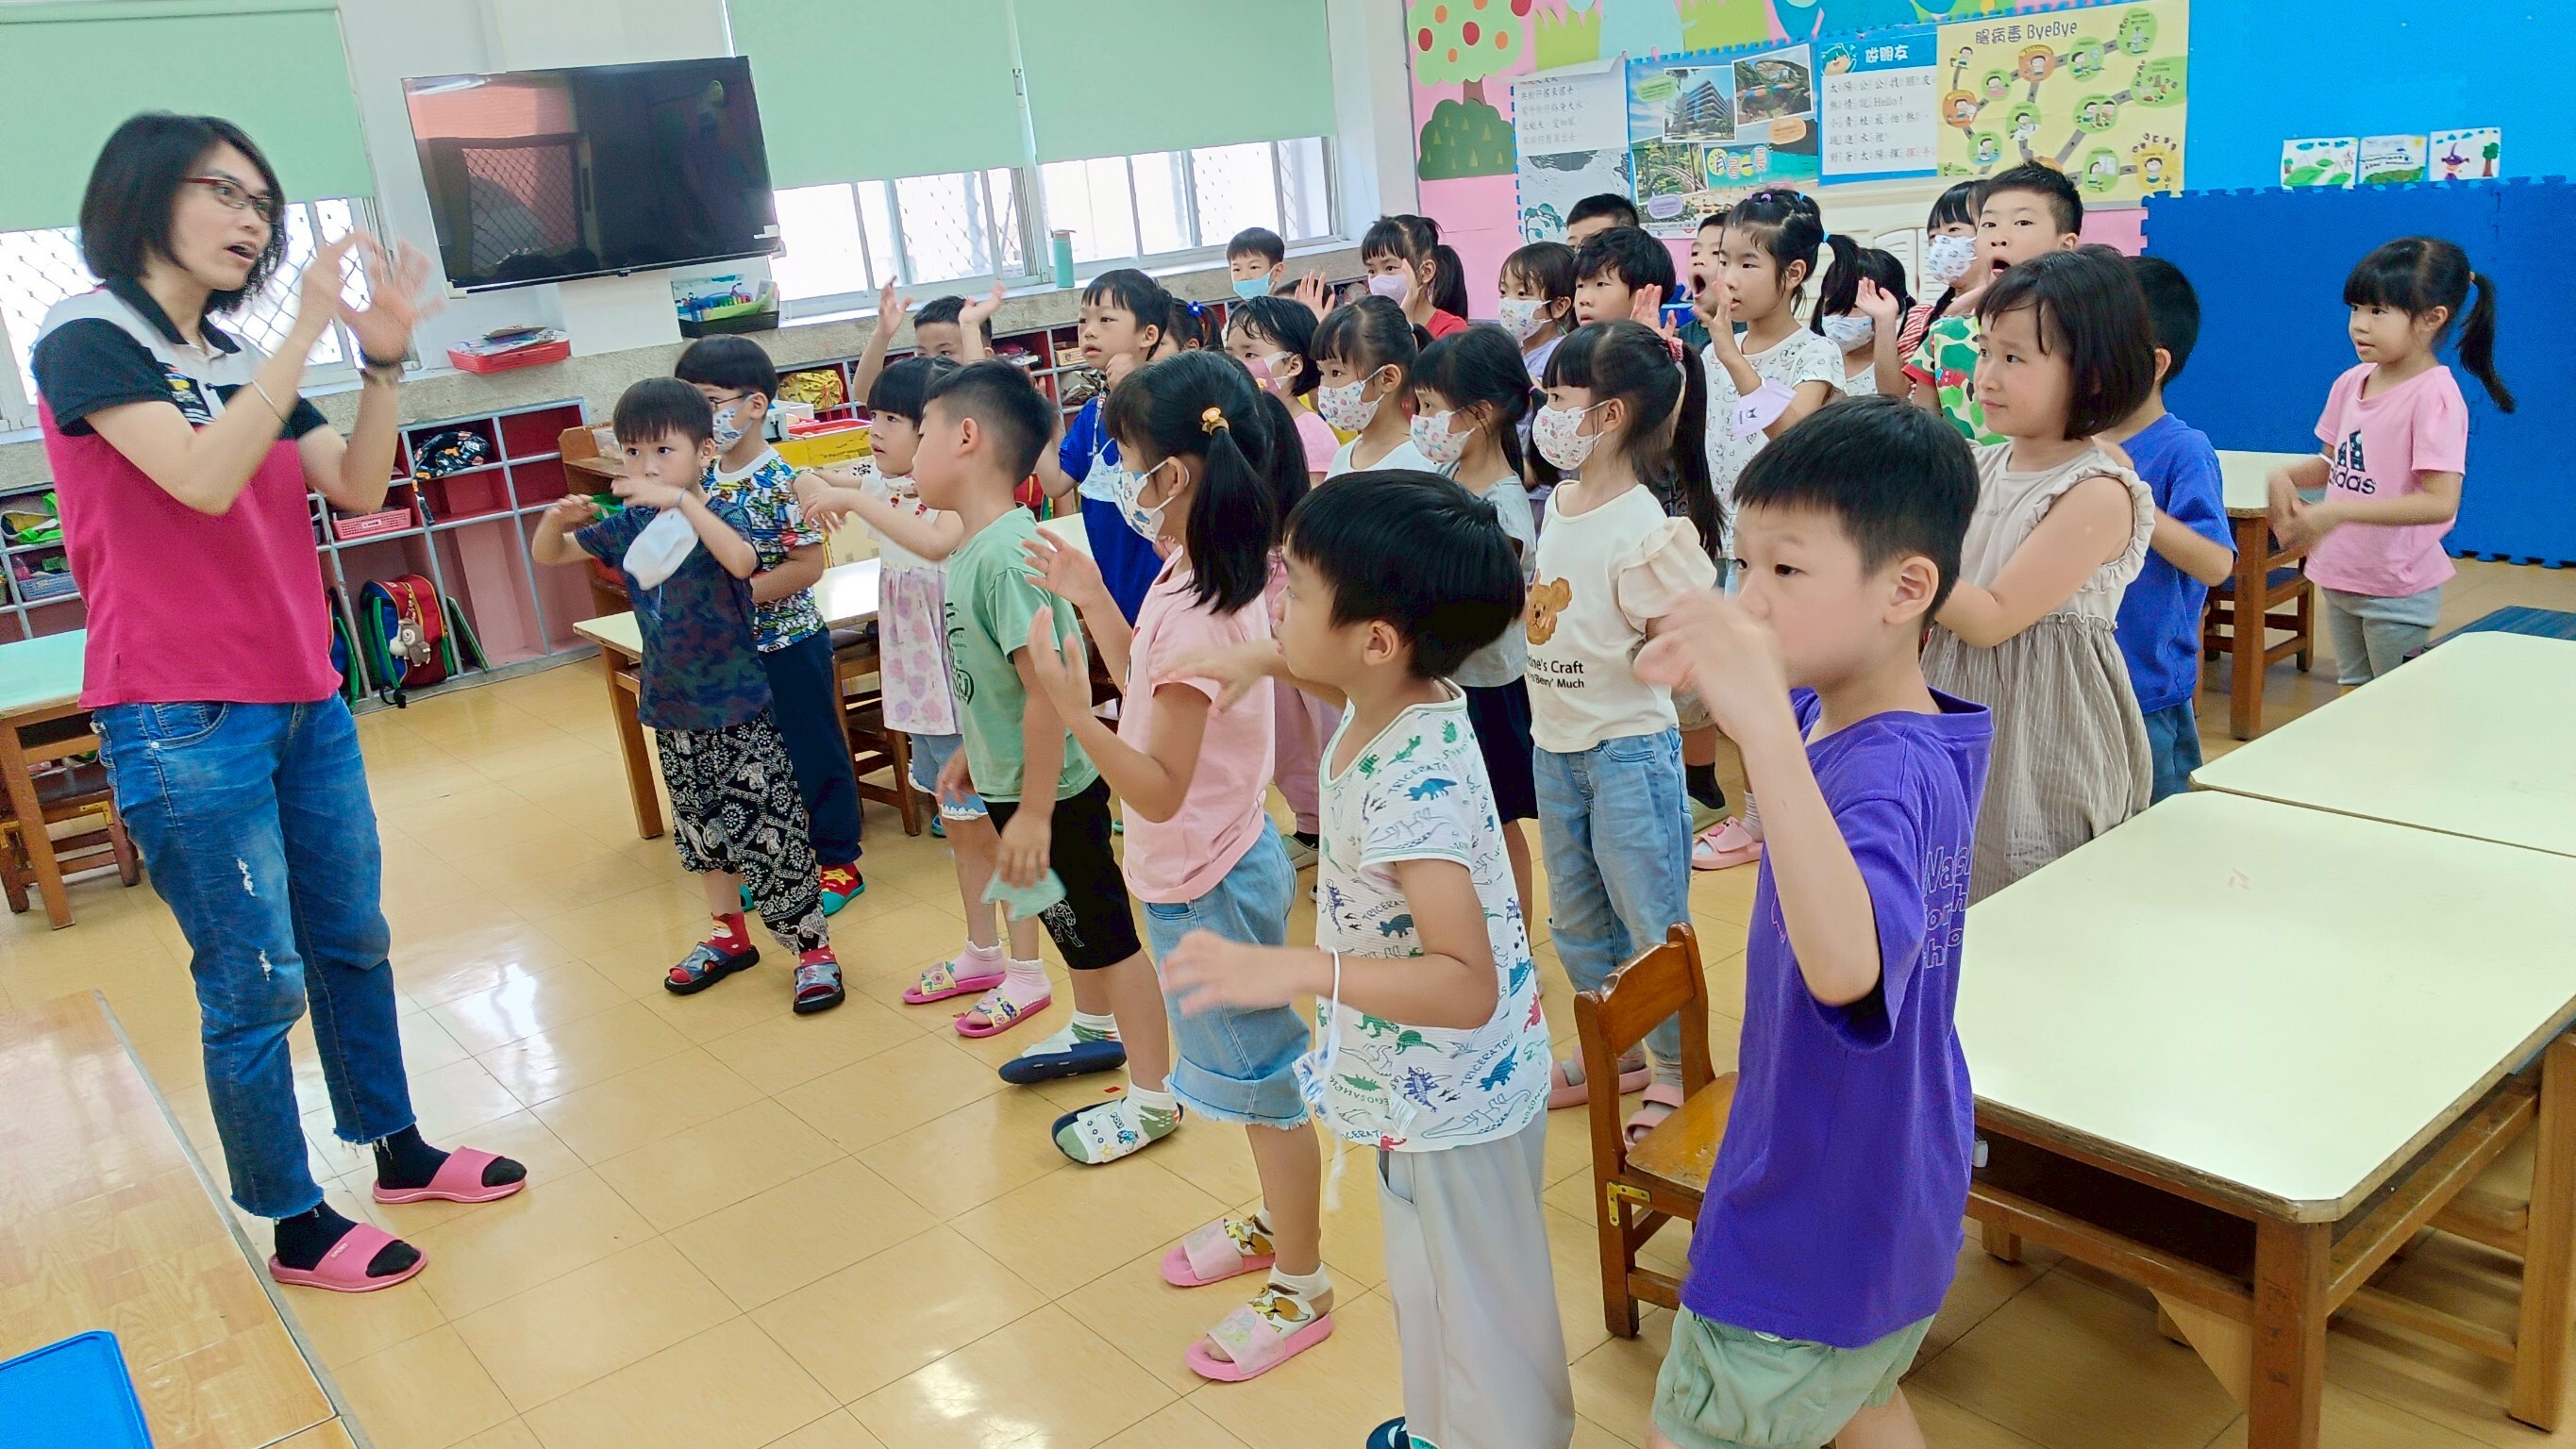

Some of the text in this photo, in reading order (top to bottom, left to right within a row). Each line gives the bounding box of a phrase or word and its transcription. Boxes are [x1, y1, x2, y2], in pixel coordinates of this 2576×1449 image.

[2026, 21, 2078, 41] ByeBye
[1550, 660, 1584, 675] Craft
[1557, 678, 1584, 689] Much
